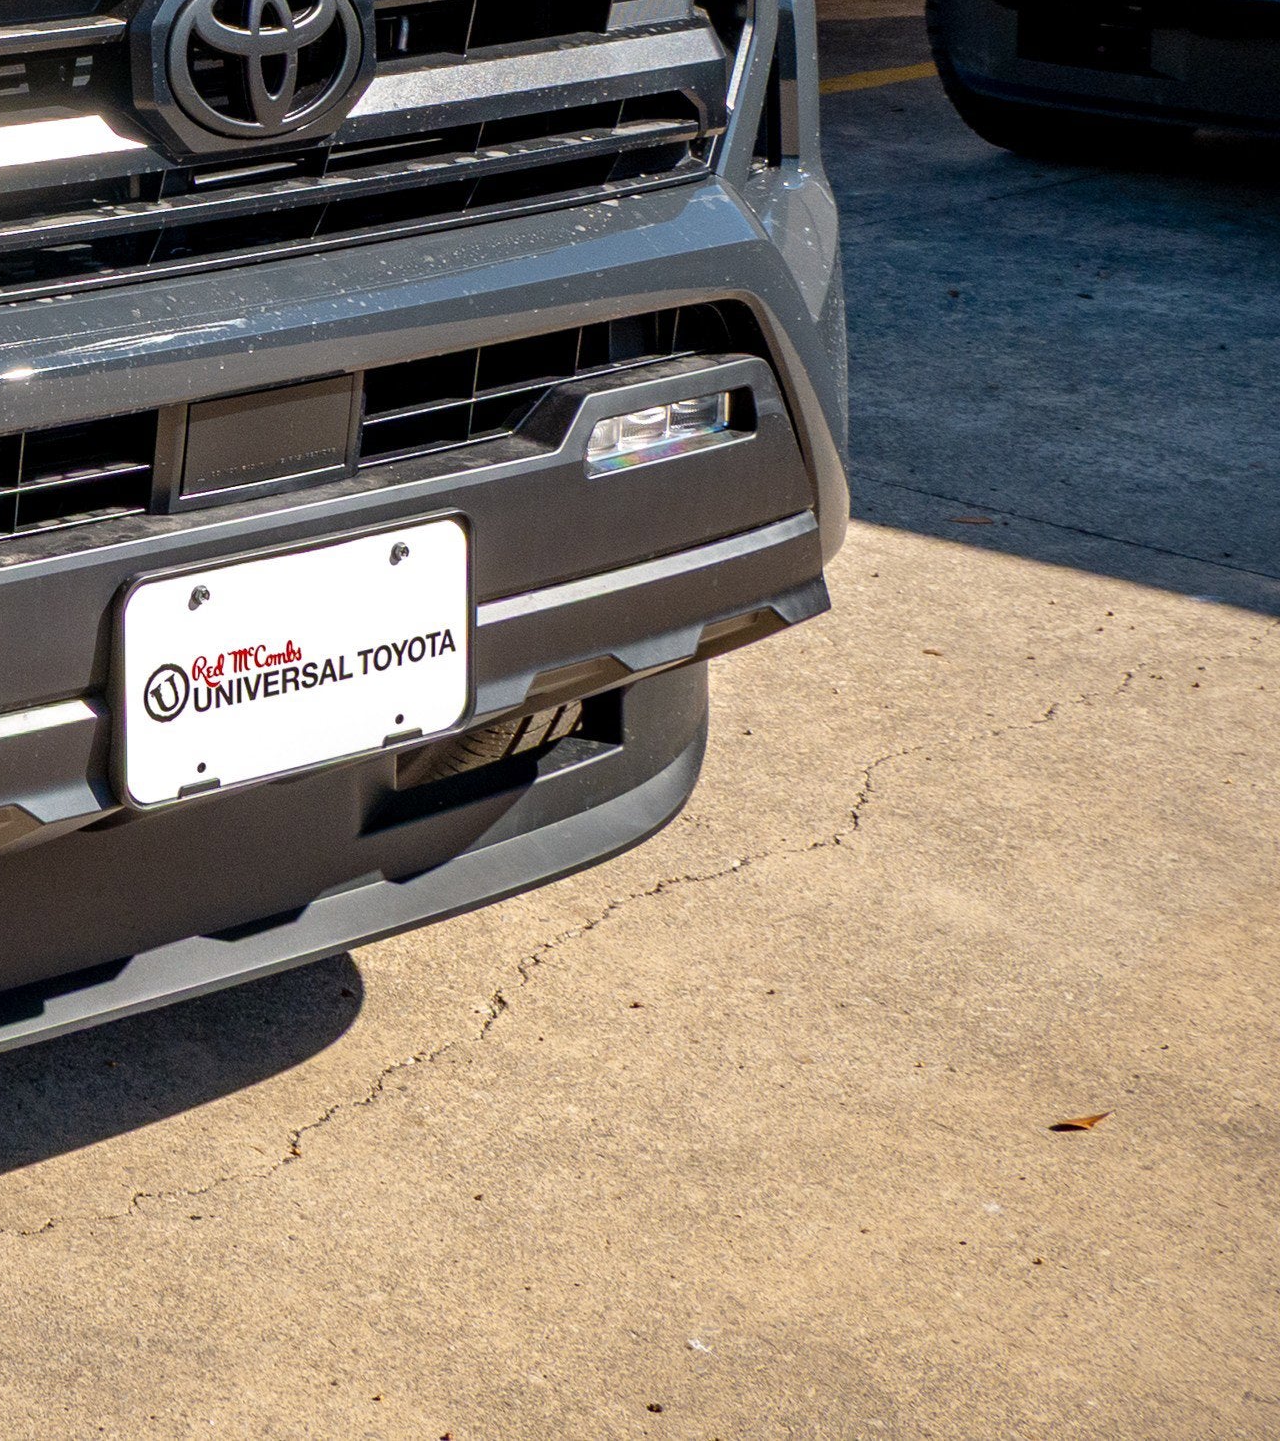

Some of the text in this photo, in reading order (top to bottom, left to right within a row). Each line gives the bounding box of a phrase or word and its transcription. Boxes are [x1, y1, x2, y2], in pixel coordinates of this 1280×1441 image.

[191, 653, 225, 688] Red
[193, 628, 457, 713] UNIVERSAL TOYOTA
